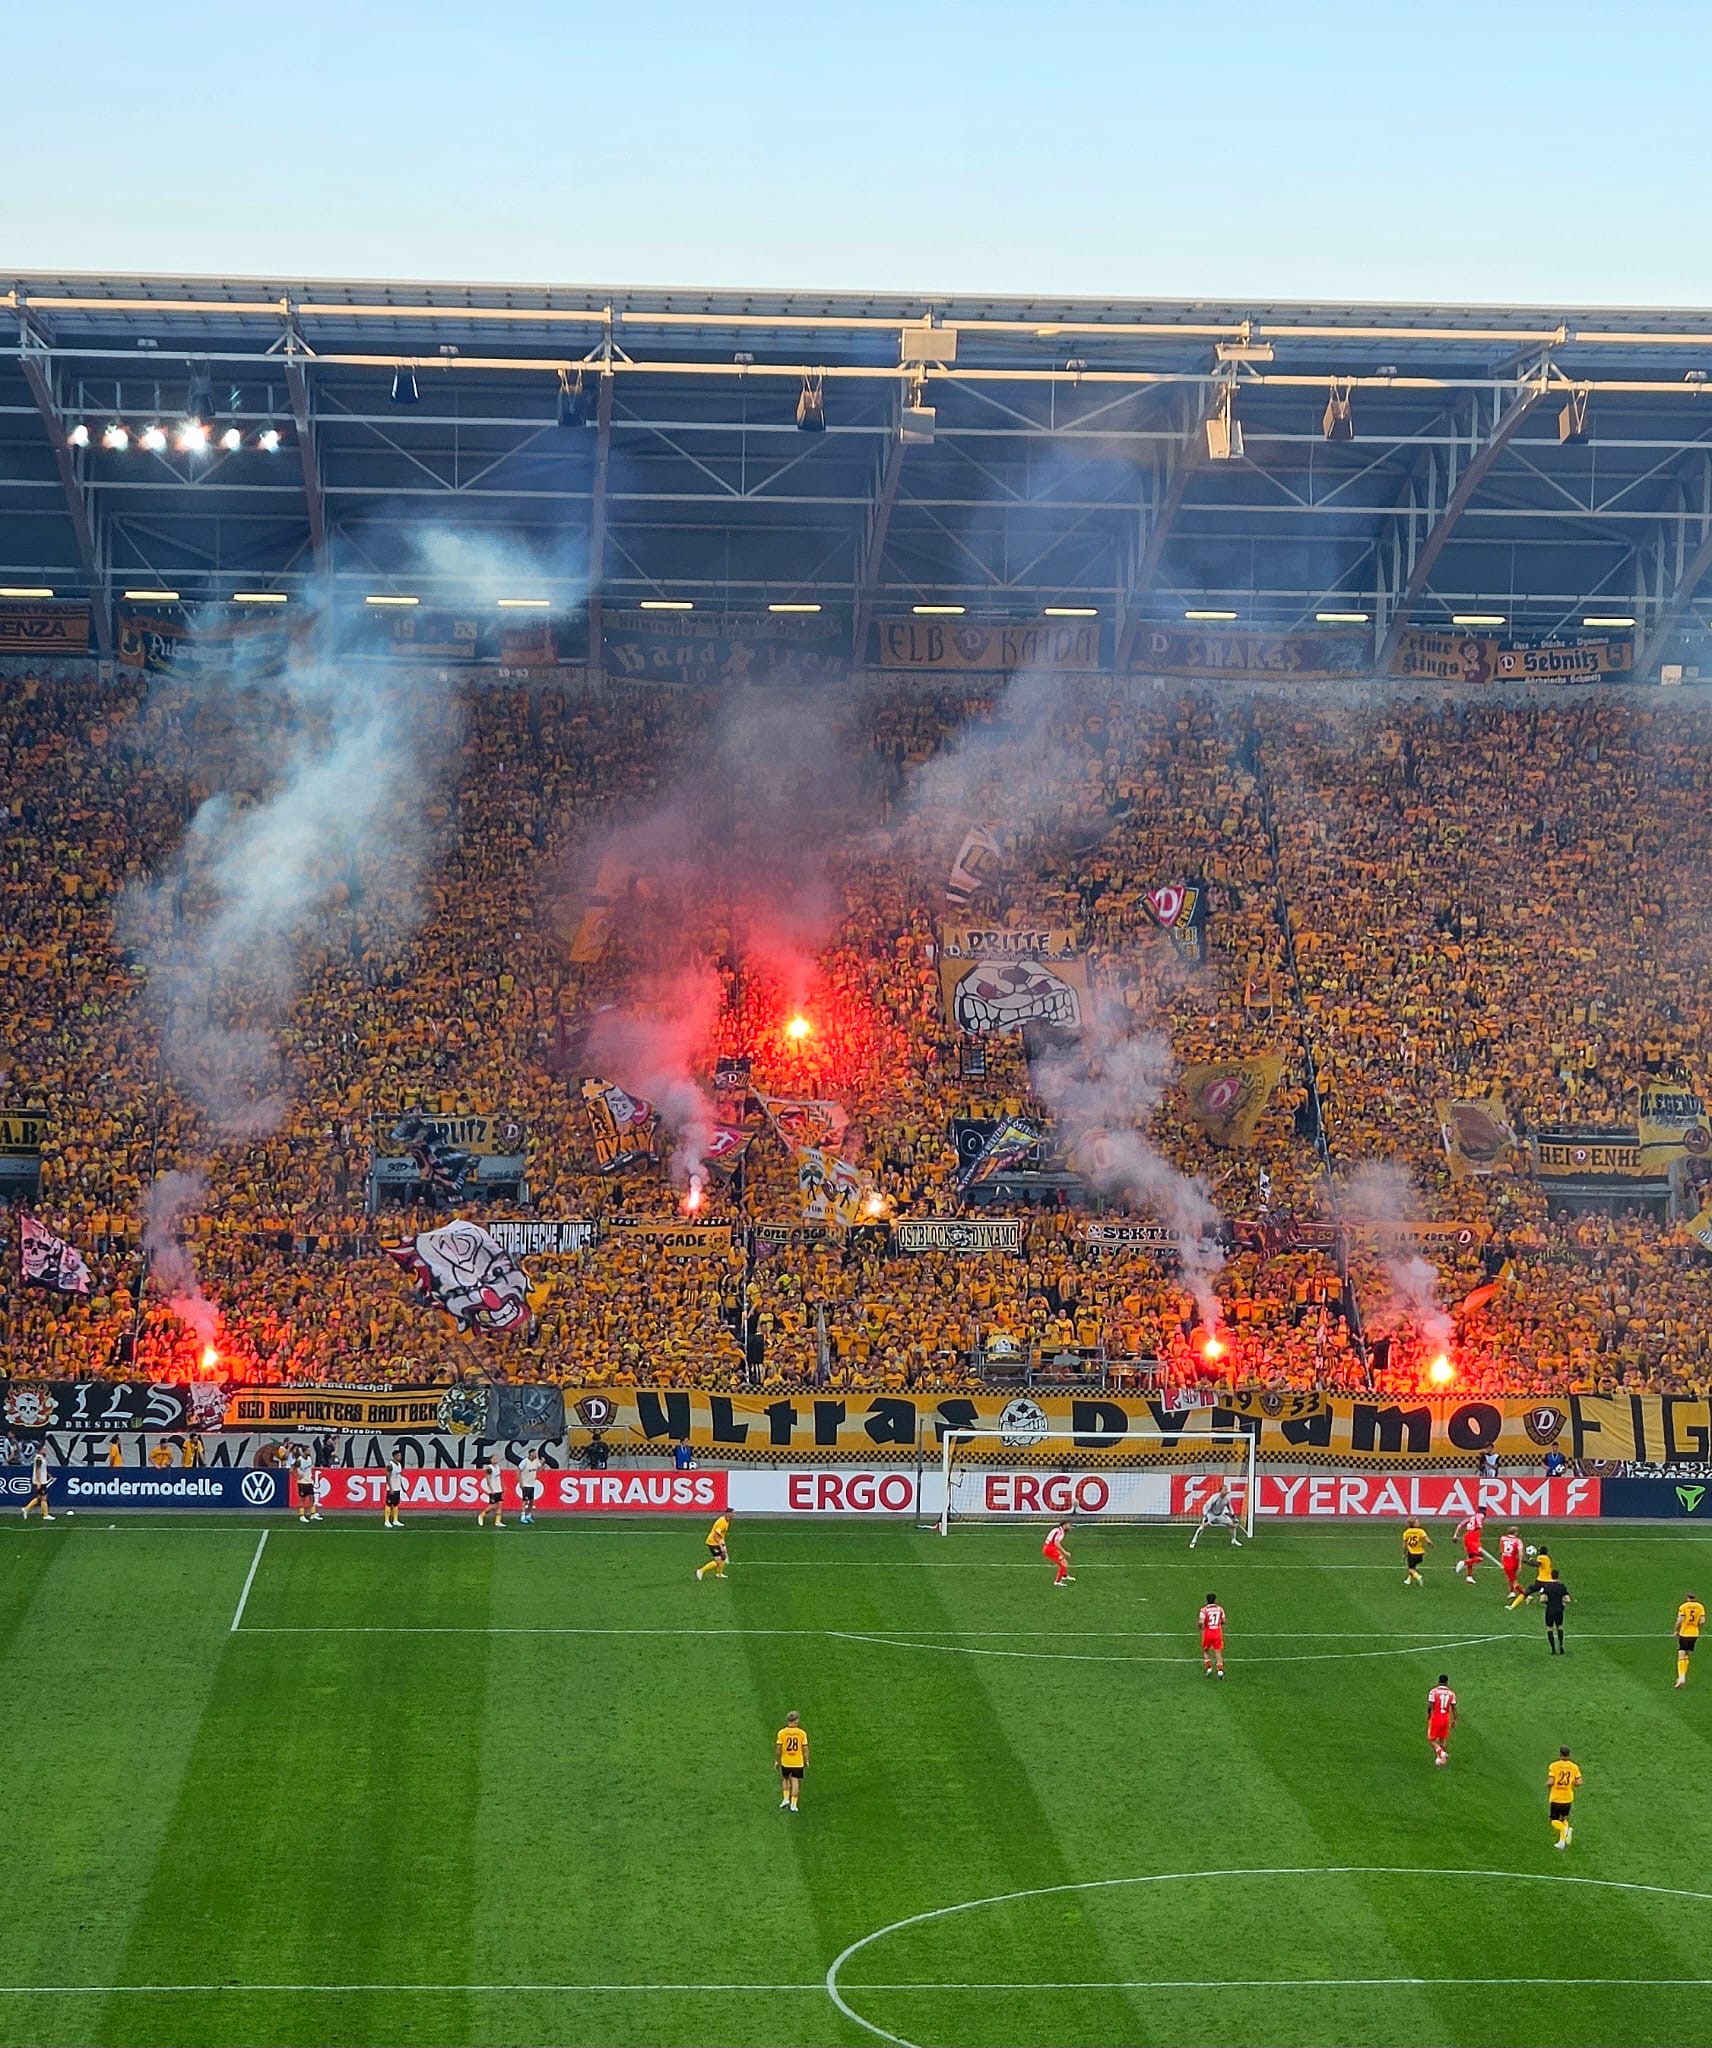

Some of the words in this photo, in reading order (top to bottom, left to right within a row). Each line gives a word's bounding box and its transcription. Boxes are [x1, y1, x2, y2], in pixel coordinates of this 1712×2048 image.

[888, 625, 944, 662] ELB
[1523, 649, 1600, 673] Sebnitz
[967, 931, 1050, 951] DRITTE
[900, 1226, 952, 1246] OSTBLOCK
[972, 1226, 1017, 1246] DYNAMO
[269, 1400, 363, 1422] SUPPORTERS
[368, 1402, 438, 1424] BAUTZEN
[1291, 1393, 1320, 1416] 53
[65, 1420, 129, 1429] DRESDEN
[297, 1424, 338, 1434] Dynamo
[341, 1426, 383, 1435] Dresden
[67, 1477, 224, 1496] Sondermodelle
[347, 1474, 493, 1503] STRAUSS
[560, 1476, 715, 1504] STRAUSS
[788, 1473, 914, 1511] ERGO
[985, 1474, 1110, 1513] ERGO
[1222, 1475, 1549, 1516] FLYERALARM
[1689, 1610, 1696, 1622] 5
[786, 1736, 799, 1752] 28
[1557, 1770, 1571, 1786] 23
